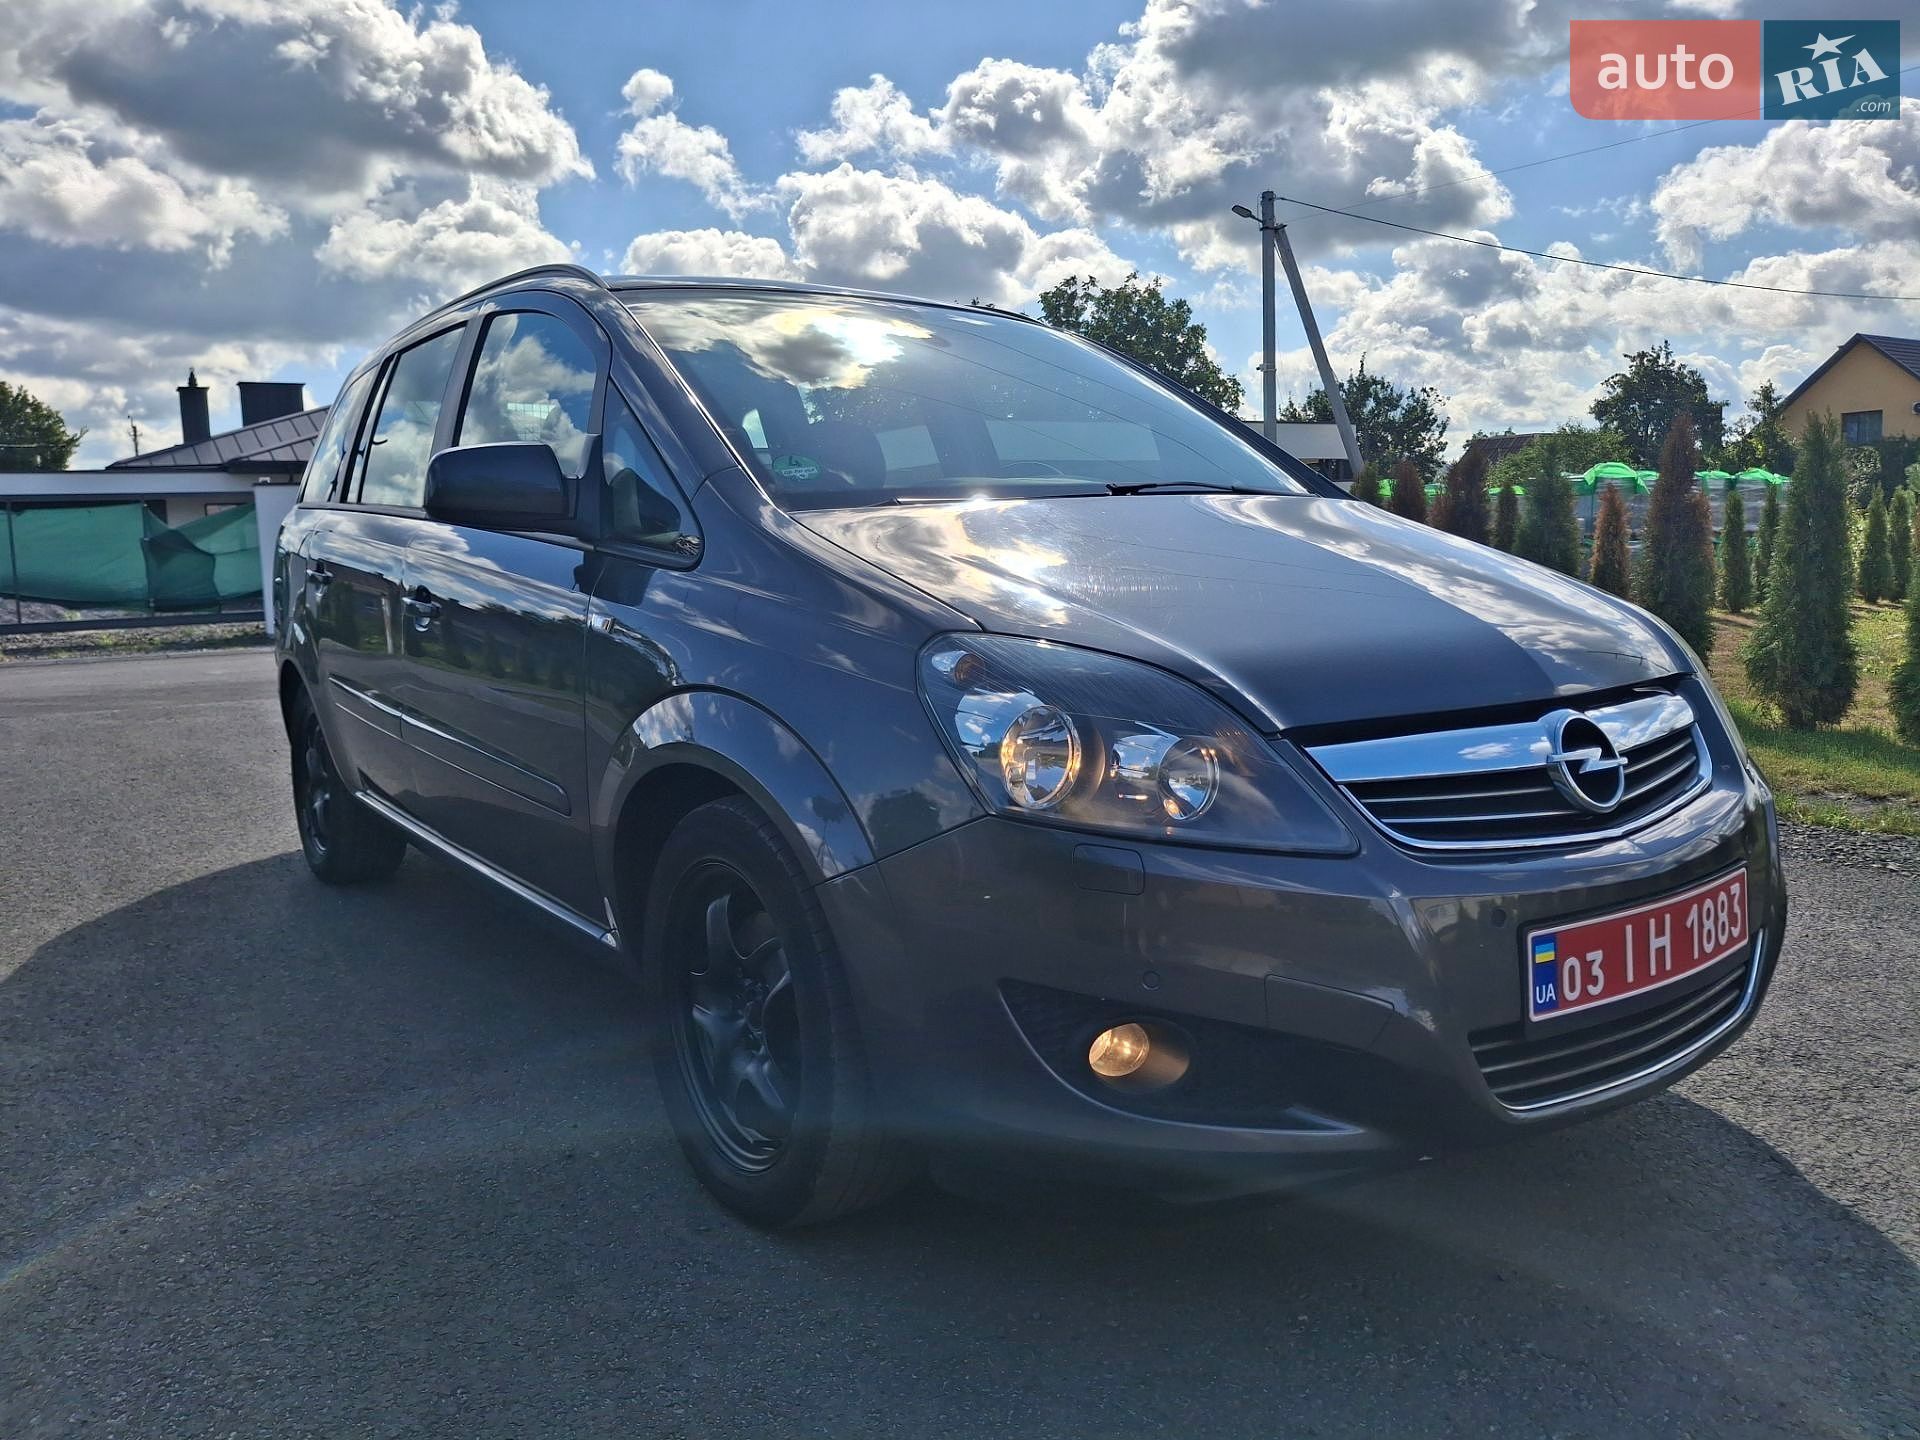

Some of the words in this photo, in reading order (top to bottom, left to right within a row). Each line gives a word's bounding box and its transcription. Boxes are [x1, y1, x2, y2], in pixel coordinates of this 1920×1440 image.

[1562, 950, 1605, 1002] 03
[1686, 882, 1742, 960] 1883
[1536, 984, 1557, 1004] UA
